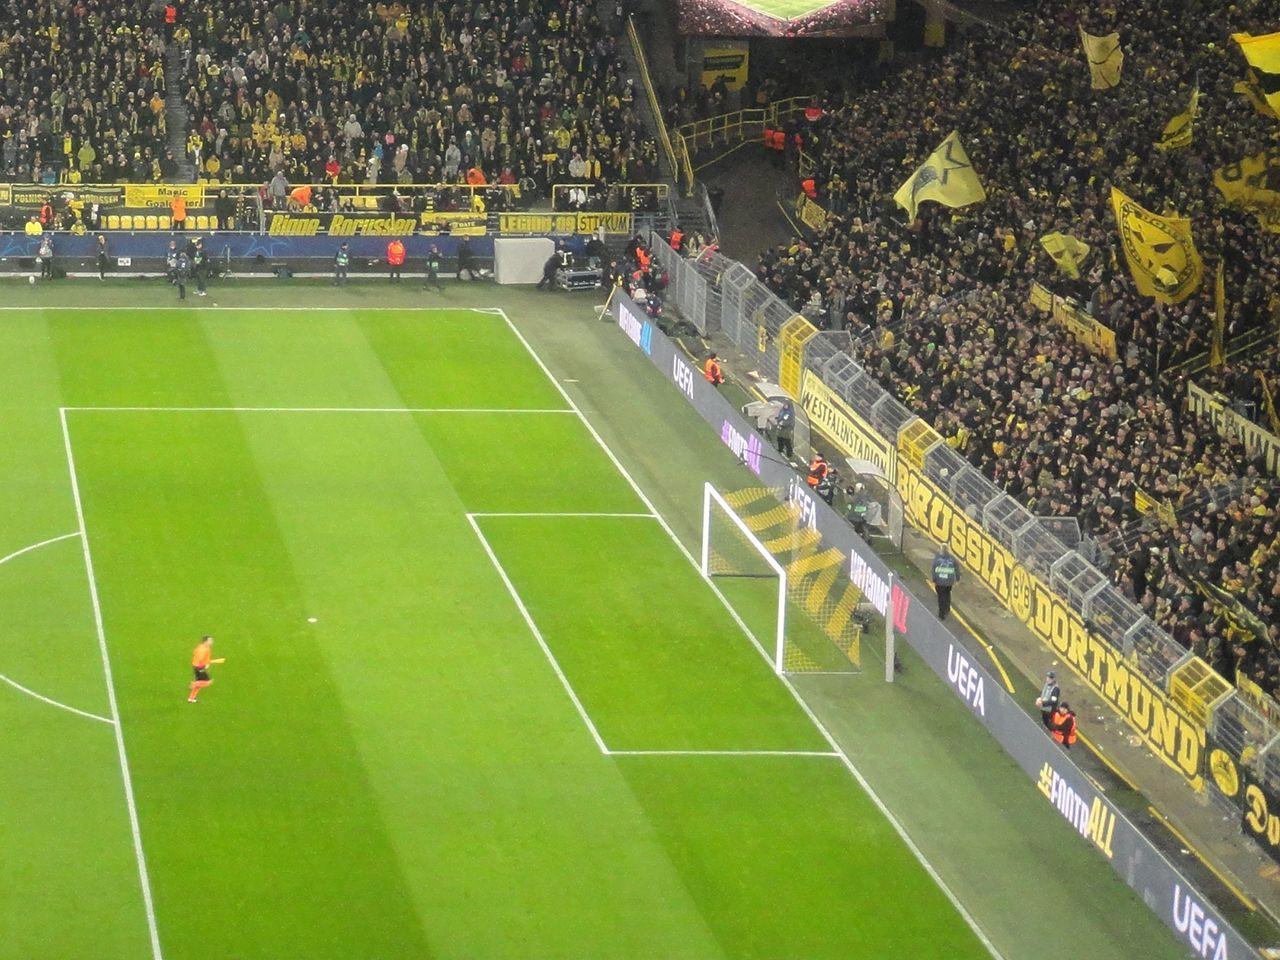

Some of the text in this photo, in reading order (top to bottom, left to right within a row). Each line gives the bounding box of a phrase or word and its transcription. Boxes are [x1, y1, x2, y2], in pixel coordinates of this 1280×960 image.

[157, 188, 188, 197] Magic
[673, 353, 694, 400] UEFA
[802, 389, 888, 477] WESTFALENSTADION
[789, 478, 817, 533] UEFA
[897, 461, 1013, 602] BORUSSIA
[947, 643, 986, 717] UEFA
[1034, 584, 1202, 778] DORTMUND
